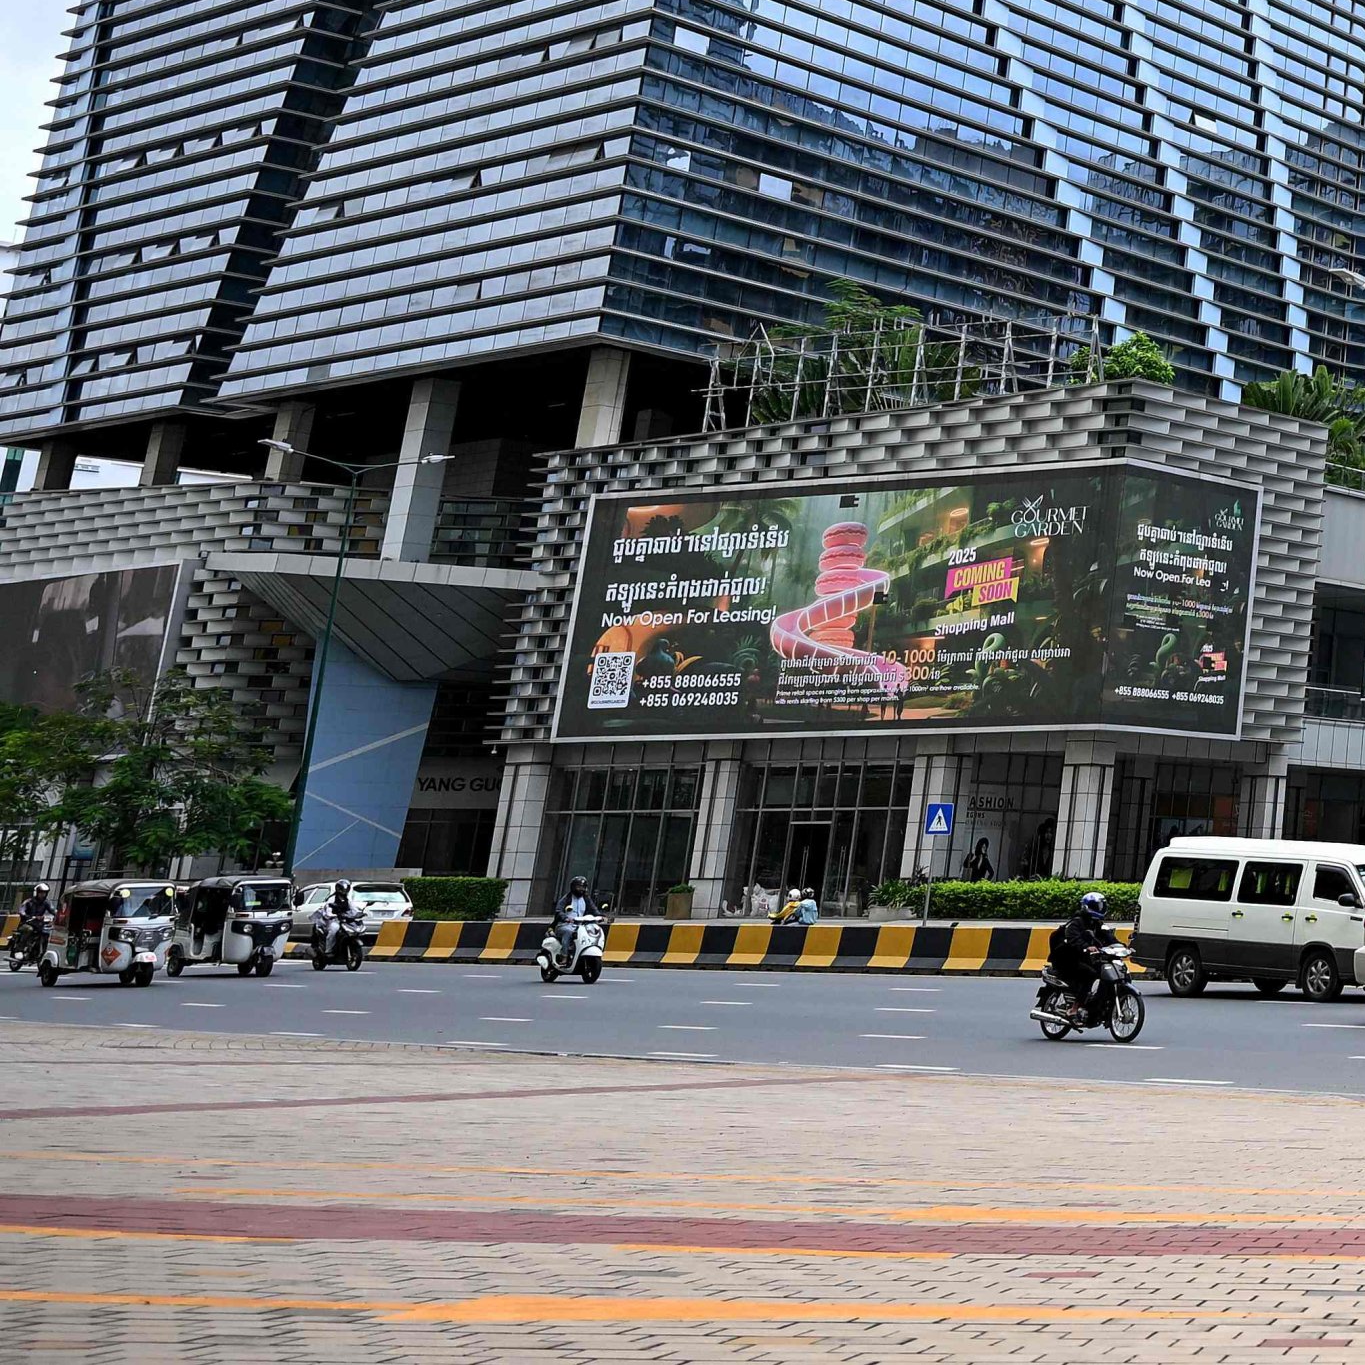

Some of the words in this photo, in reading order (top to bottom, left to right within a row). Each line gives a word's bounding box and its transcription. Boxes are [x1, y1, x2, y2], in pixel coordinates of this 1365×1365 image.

[1011, 503, 1091, 524] GOURMET
[1015, 520, 1084, 538] GARDEN
[948, 547, 977, 566] 2025
[953, 561, 1006, 588] COMING
[1133, 566, 1153, 579] Now
[1155, 570, 1180, 583] Open
[1181, 574, 1195, 584] For
[978, 581, 1013, 603] SOON
[601, 612, 636, 628] Now
[639, 610, 682, 627] Open
[686, 609, 710, 624] For
[713, 605, 776, 625] Leasing!
[934, 617, 988, 636] Shopping
[990, 611, 1016, 626] Mall
[642, 675, 671, 689] +855
[675, 673, 741, 688] 888066555
[639, 693, 669, 707] +855
[671, 692, 738, 707] 069248035
[1114, 685, 1132, 696] +855
[1132, 687, 1170, 700] 888066555
[1171, 691, 1189, 702] +855
[1189, 692, 1225, 705] 069248035
[418, 777, 466, 792] YANG
[968, 796, 1015, 809] ASHION
